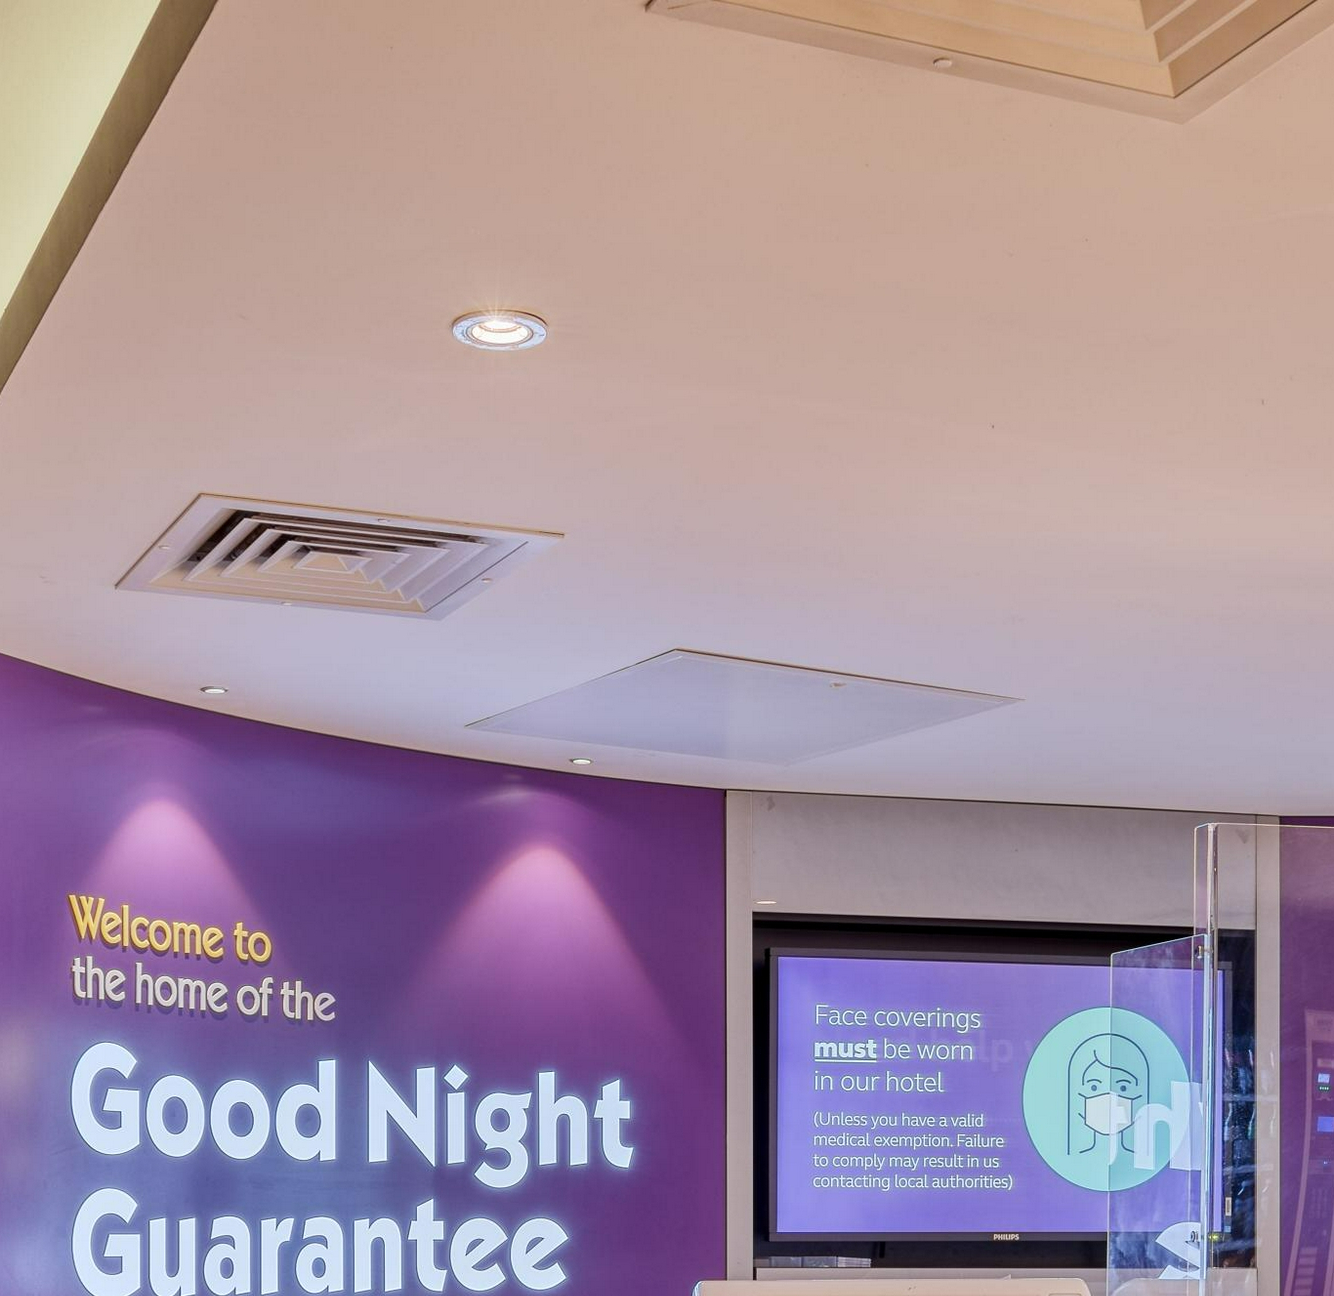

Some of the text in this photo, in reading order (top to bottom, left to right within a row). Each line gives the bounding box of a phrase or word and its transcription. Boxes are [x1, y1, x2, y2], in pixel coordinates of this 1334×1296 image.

[69, 895, 272, 962] Welcome to
[72, 957, 336, 1021] the home of the
[815, 1004, 981, 1033] Face coverings
[814, 1039, 877, 1060] must
[883, 1038, 910, 1060] be
[916, 1044, 973, 1060] worn
[814, 1071, 945, 1093] in our hotel
[70, 1042, 634, 1188] Good Night
[813, 1111, 984, 1129] (Unless you have a valid
[813, 1133, 1005, 1150] medical exemption. Failure
[813, 1154, 1000, 1171] to comply may result in us
[813, 1174, 1013, 1191] contacting local authorities)
